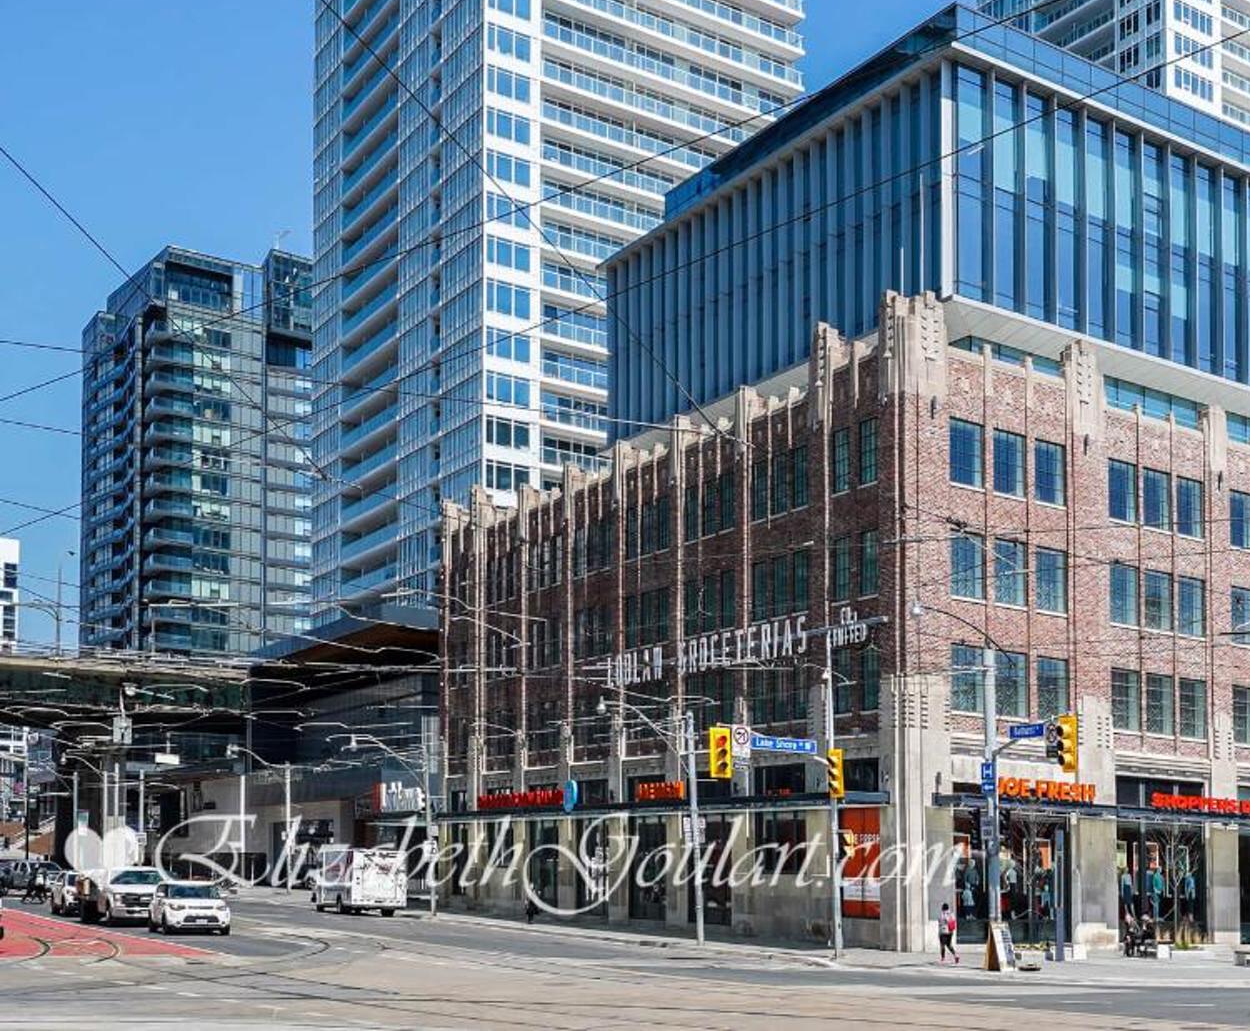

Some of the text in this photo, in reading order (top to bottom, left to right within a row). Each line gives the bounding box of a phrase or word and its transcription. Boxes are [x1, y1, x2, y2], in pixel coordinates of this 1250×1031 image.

[677, 615, 808, 676] GROCETERIAS
[755, 736, 774, 747] Lake
[1035, 779, 1096, 804] FRESH
[1151, 791, 1239, 814] SHOPPERS
